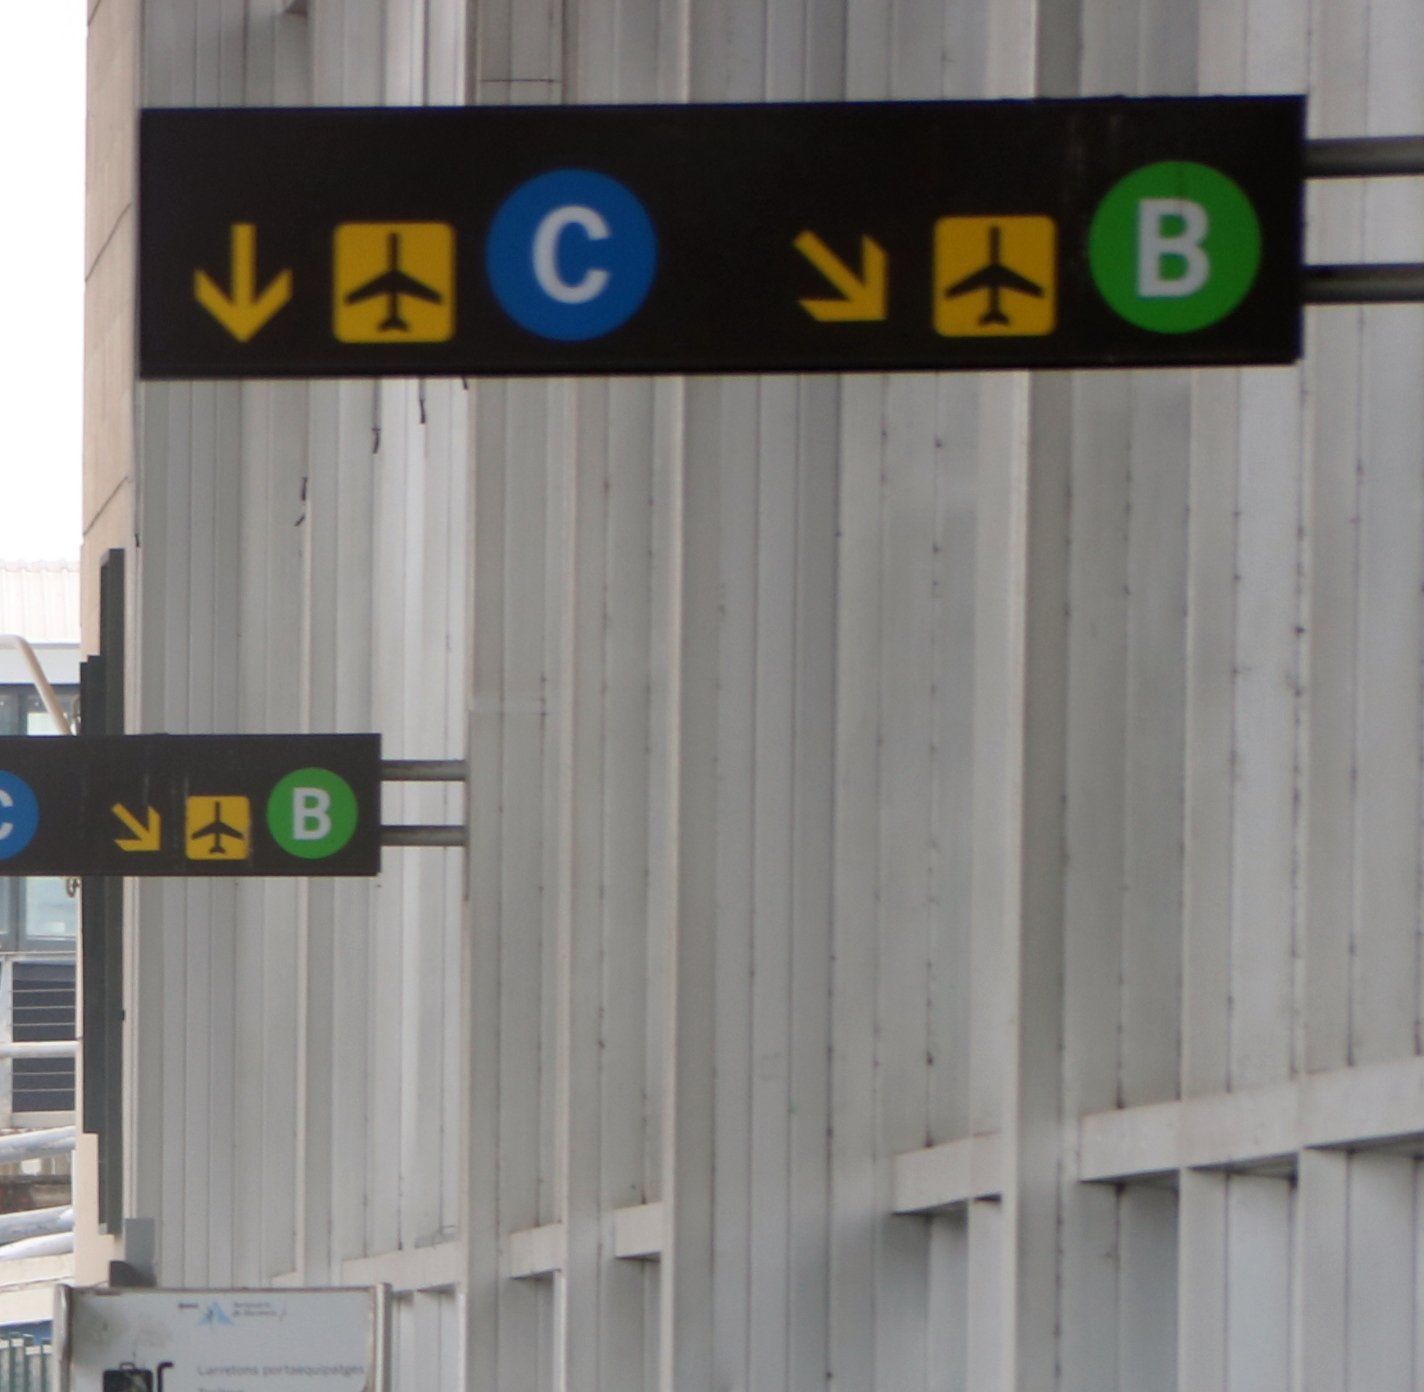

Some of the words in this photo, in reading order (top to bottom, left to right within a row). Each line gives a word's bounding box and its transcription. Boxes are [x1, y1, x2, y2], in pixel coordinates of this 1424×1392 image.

[533, 207, 610, 305] C
[1134, 196, 1213, 298] B
[292, 787, 332, 841] B
